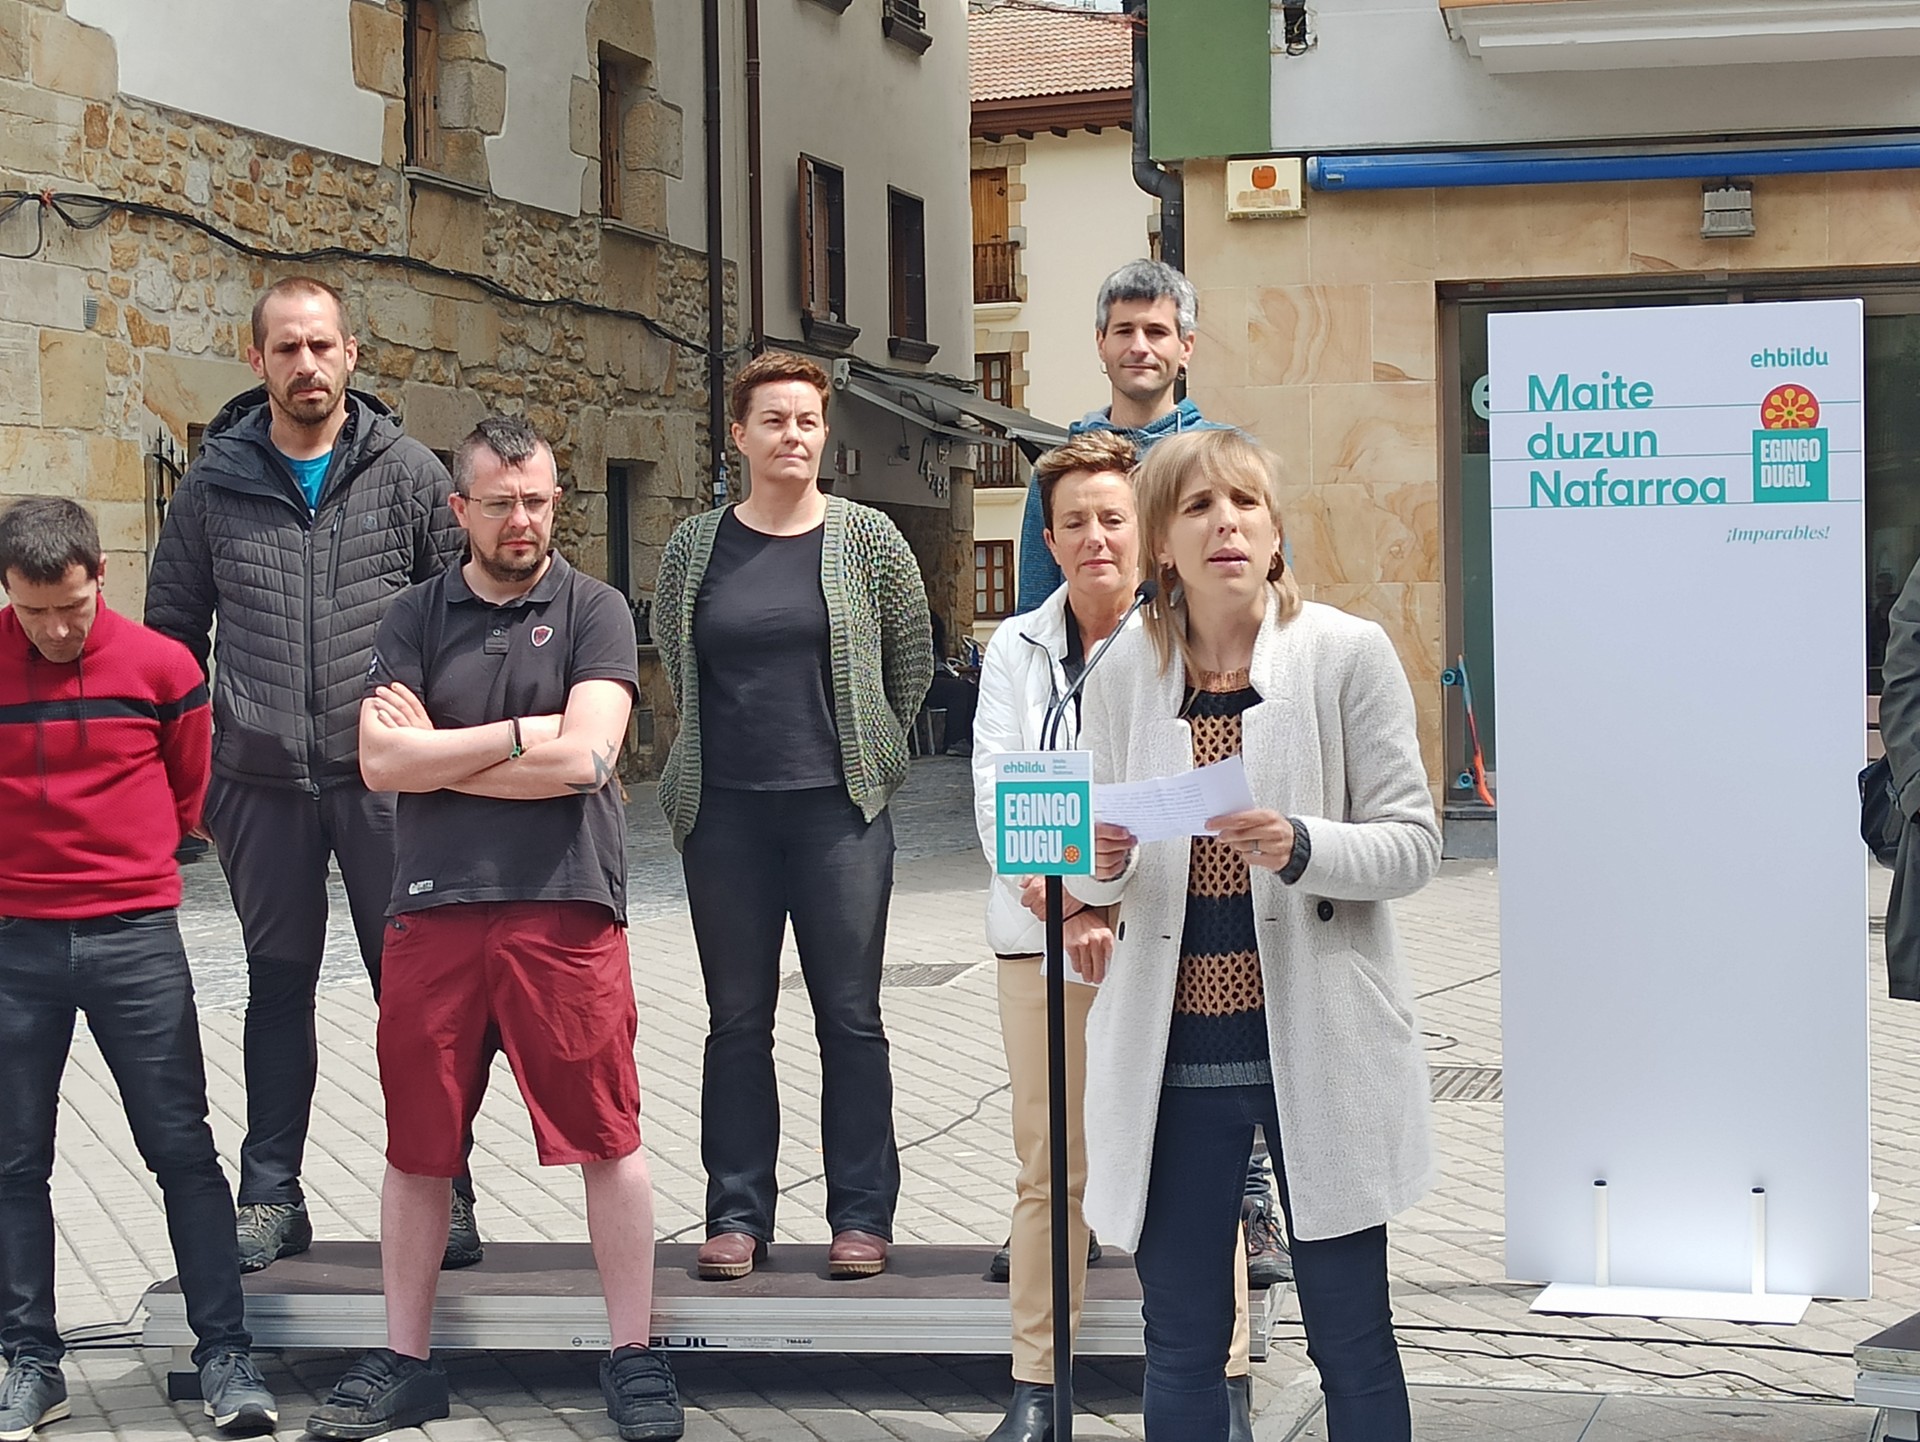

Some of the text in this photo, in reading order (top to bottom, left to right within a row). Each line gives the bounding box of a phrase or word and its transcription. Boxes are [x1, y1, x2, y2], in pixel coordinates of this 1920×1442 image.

[1750, 346, 1829, 368] ehbildu
[1527, 371, 1654, 412] Maite
[1527, 421, 1659, 459] duzun
[1760, 437, 1821, 463] EGINGO
[1529, 467, 1727, 508] Nafarroa
[1760, 464, 1811, 488] DUGU.
[1726, 525, 1831, 544] ¡Imparables!
[1003, 761, 1046, 774] ehbildu
[1004, 792, 1081, 827] EGINGO
[1005, 830, 1063, 864] DUGU
